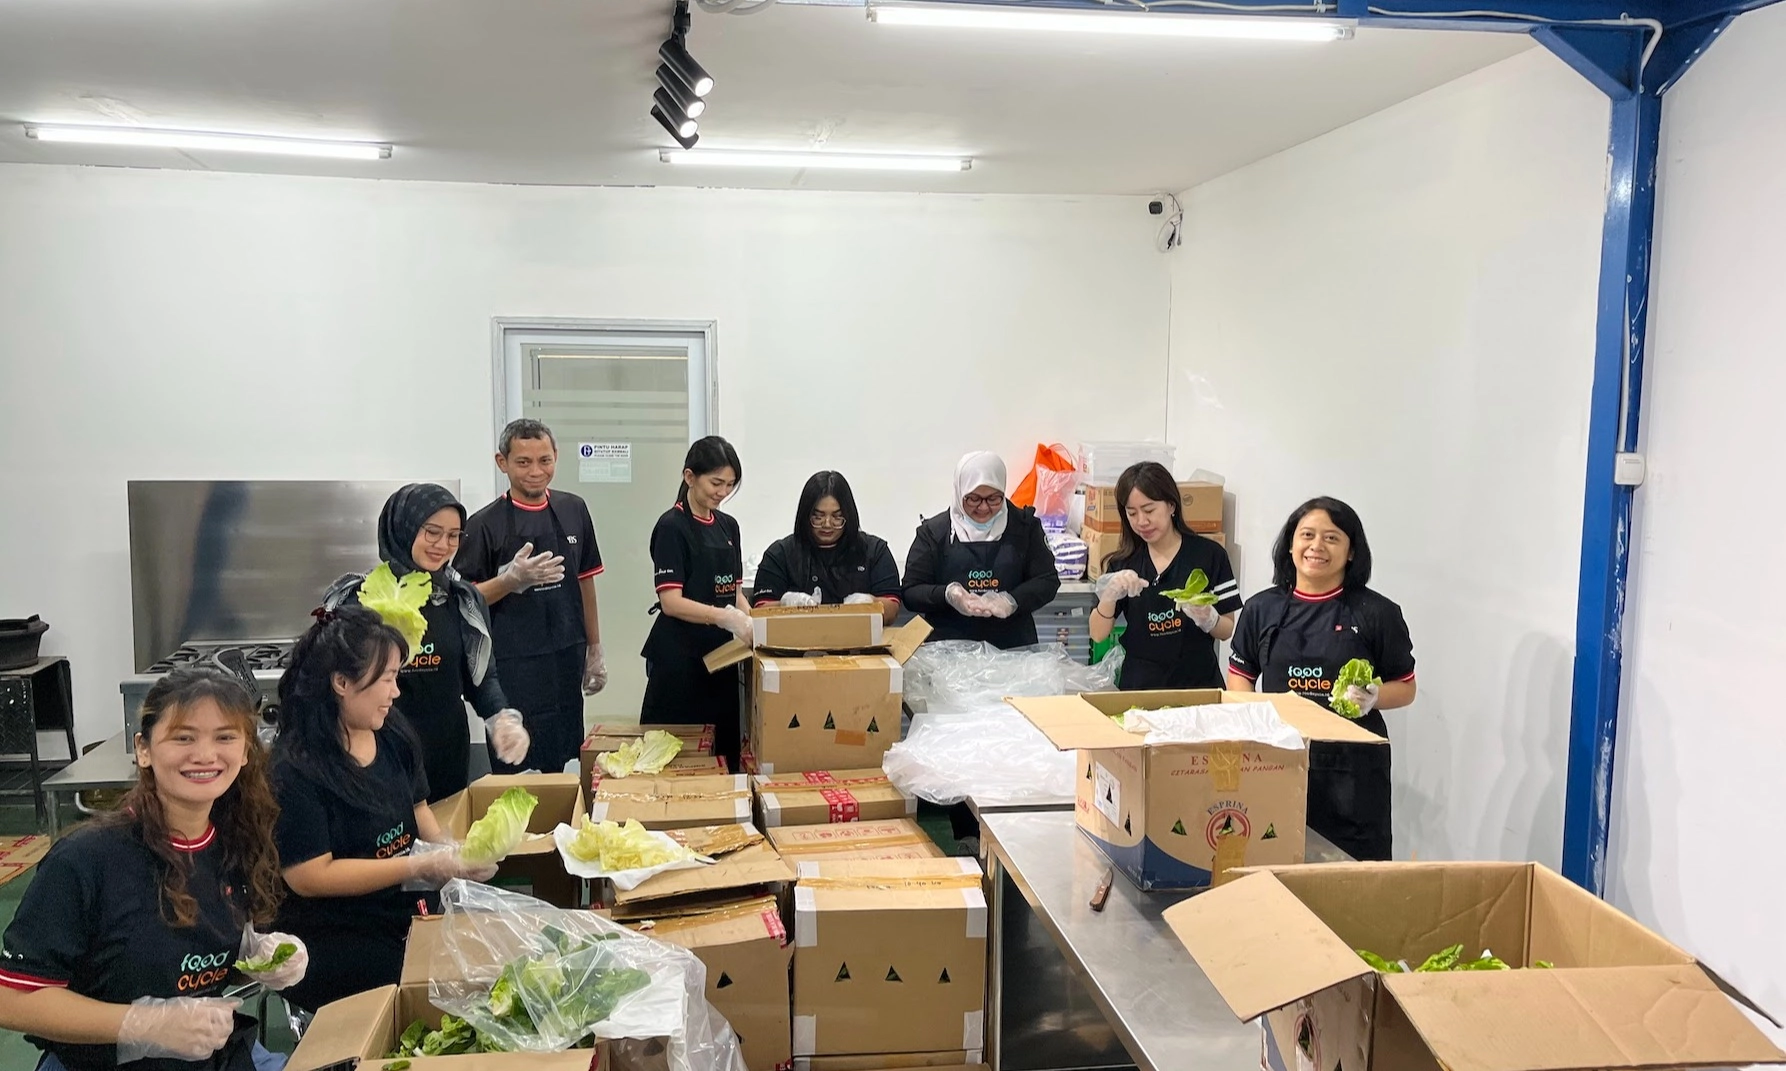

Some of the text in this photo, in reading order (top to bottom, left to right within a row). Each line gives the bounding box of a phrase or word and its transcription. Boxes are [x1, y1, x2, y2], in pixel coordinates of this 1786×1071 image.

[715, 574, 734, 584] food
[968, 570, 993, 579] food
[715, 583, 736, 594] cycle
[968, 579, 999, 588] cycle
[1148, 609, 1175, 622] food
[1148, 618, 1182, 632] cycle
[410, 655, 441, 668] ycle
[1288, 665, 1323, 679] food
[1288, 678, 1331, 691] cycle
[1207, 800, 1249, 817] ESPRINA
[376, 821, 404, 848] food
[376, 833, 411, 859] cycle
[181, 950, 230, 972] food
[177, 967, 229, 991] cycle
